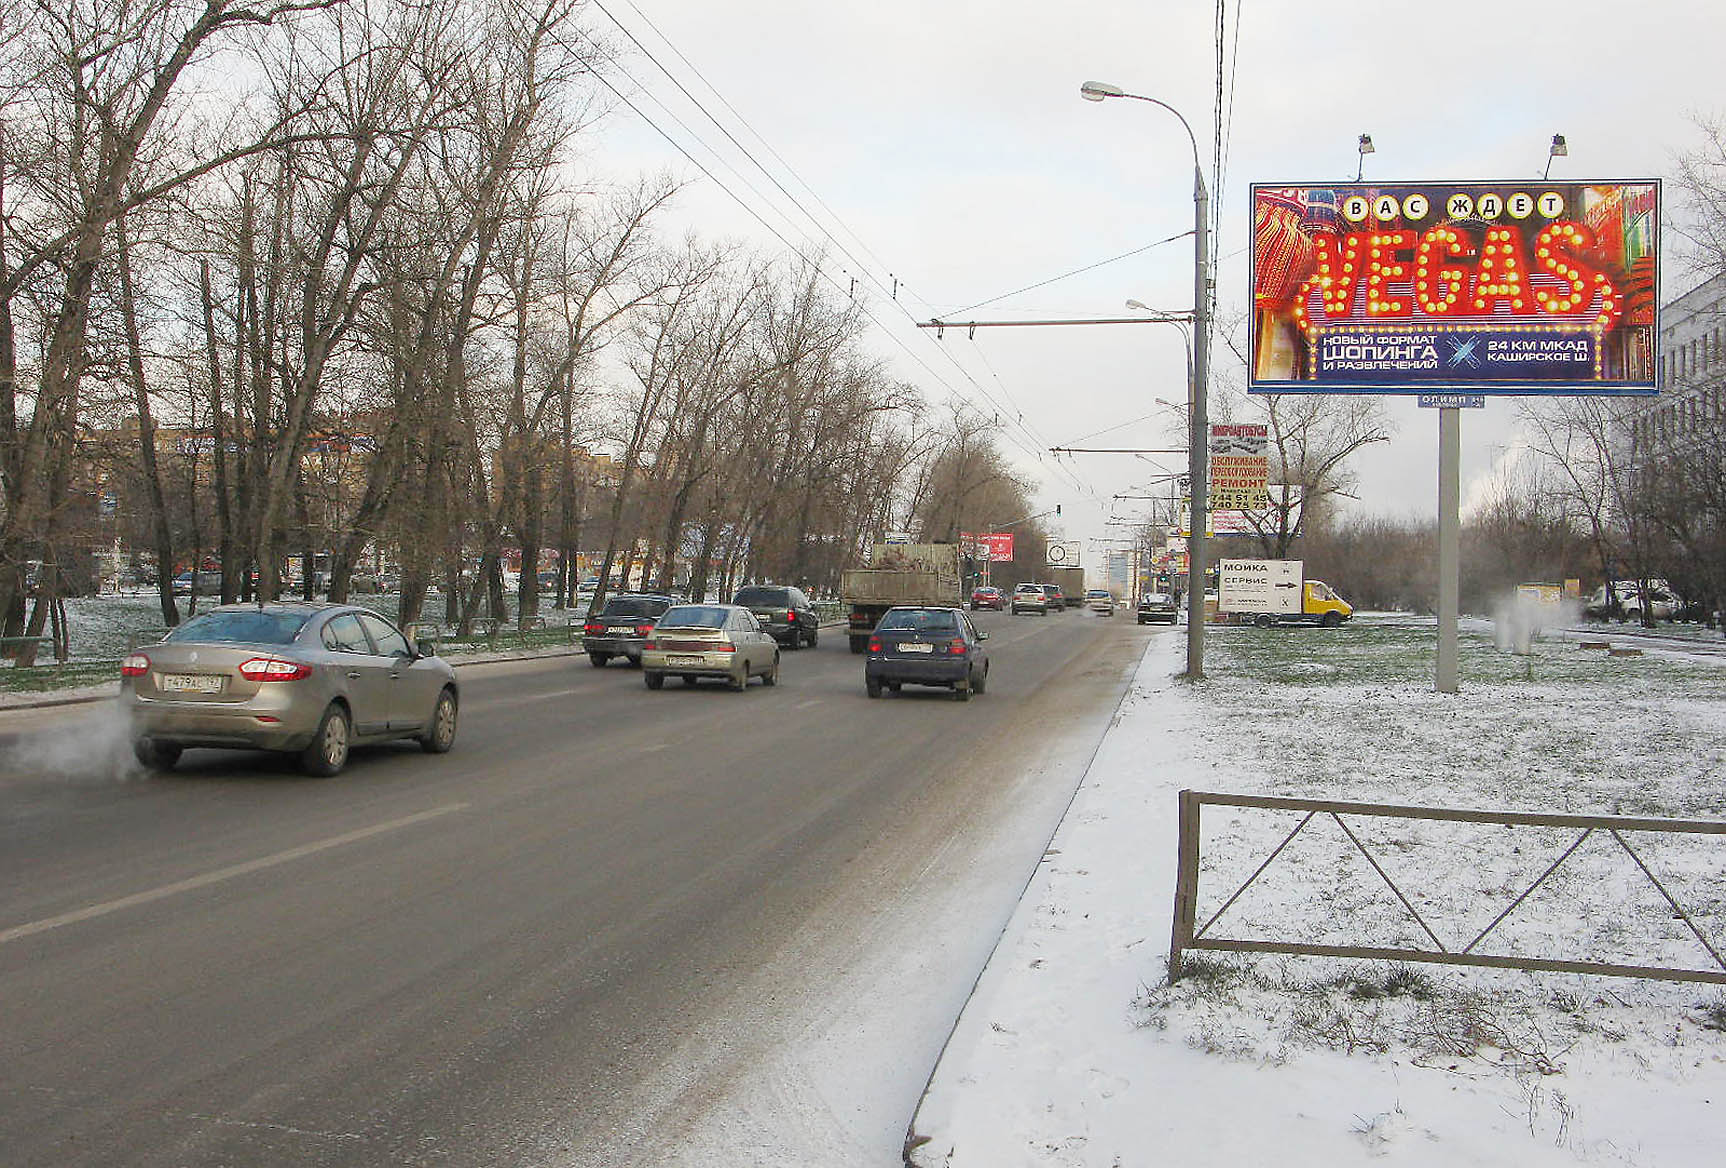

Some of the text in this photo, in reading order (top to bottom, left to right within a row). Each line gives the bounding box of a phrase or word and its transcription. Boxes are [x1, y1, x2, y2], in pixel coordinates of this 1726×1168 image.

[1350, 198, 1557, 216] ВАС ЖДЕТ
[1310, 221, 1602, 318] VEGAS
[1323, 334, 1438, 346] НОВЫЙ ФОРМАТ
[1488, 340, 1588, 352] 24 КМ МКАД
[1323, 345, 1439, 361] ШОПИНГА
[1487, 353, 1570, 361] КАШИРСКОЕ
[1323, 359, 1438, 370] И РАЗВЛЕЧЕНИЙ
[1422, 395, 1466, 404] ОЛИМП
[1212, 479, 1266, 488] РЕМОНТ
[1223, 562, 1268, 572] МОЙКА
[1224, 577, 1268, 585] СЕРВИС
